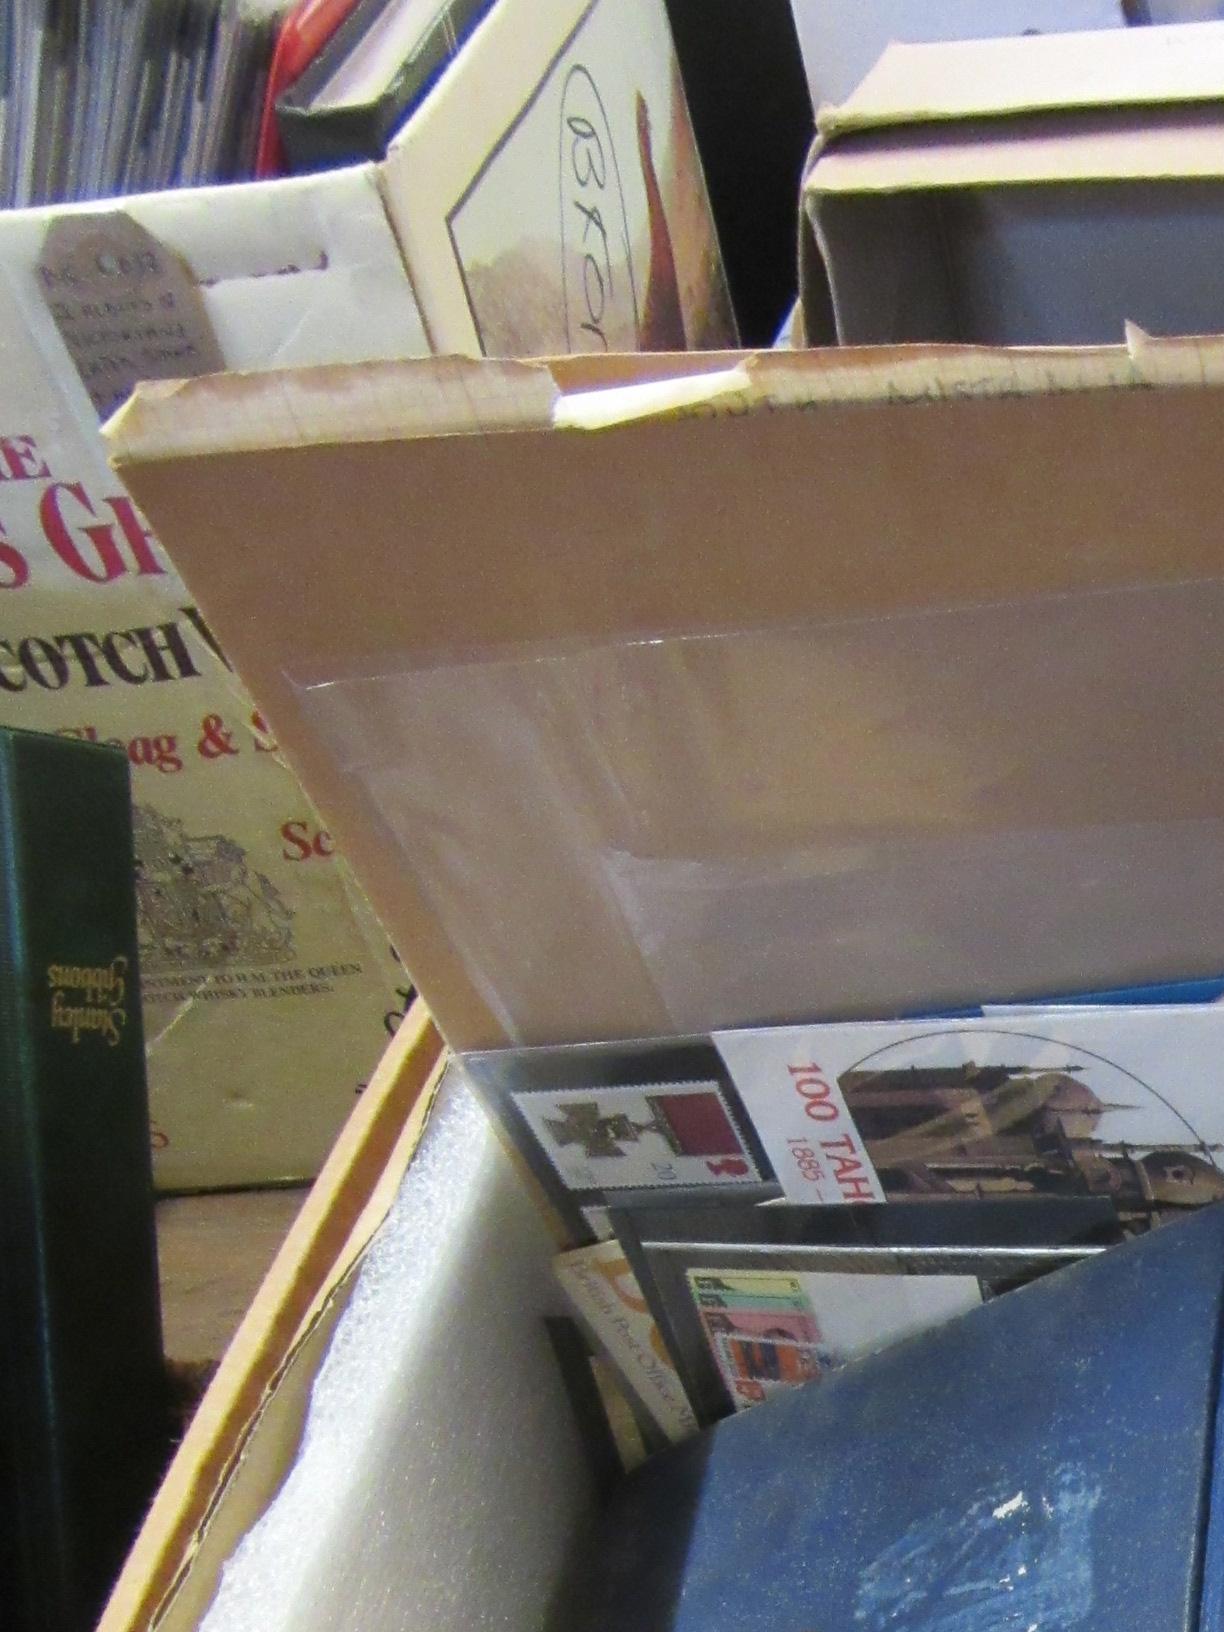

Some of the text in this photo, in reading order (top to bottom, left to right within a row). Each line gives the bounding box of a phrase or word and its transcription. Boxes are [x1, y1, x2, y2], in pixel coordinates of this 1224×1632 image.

[307, 962, 363, 980] QUEEN
[51, 1007, 128, 1047] Stanley
[787, 1062, 840, 1122] 100
[786, 1137, 826, 1181] 1885
